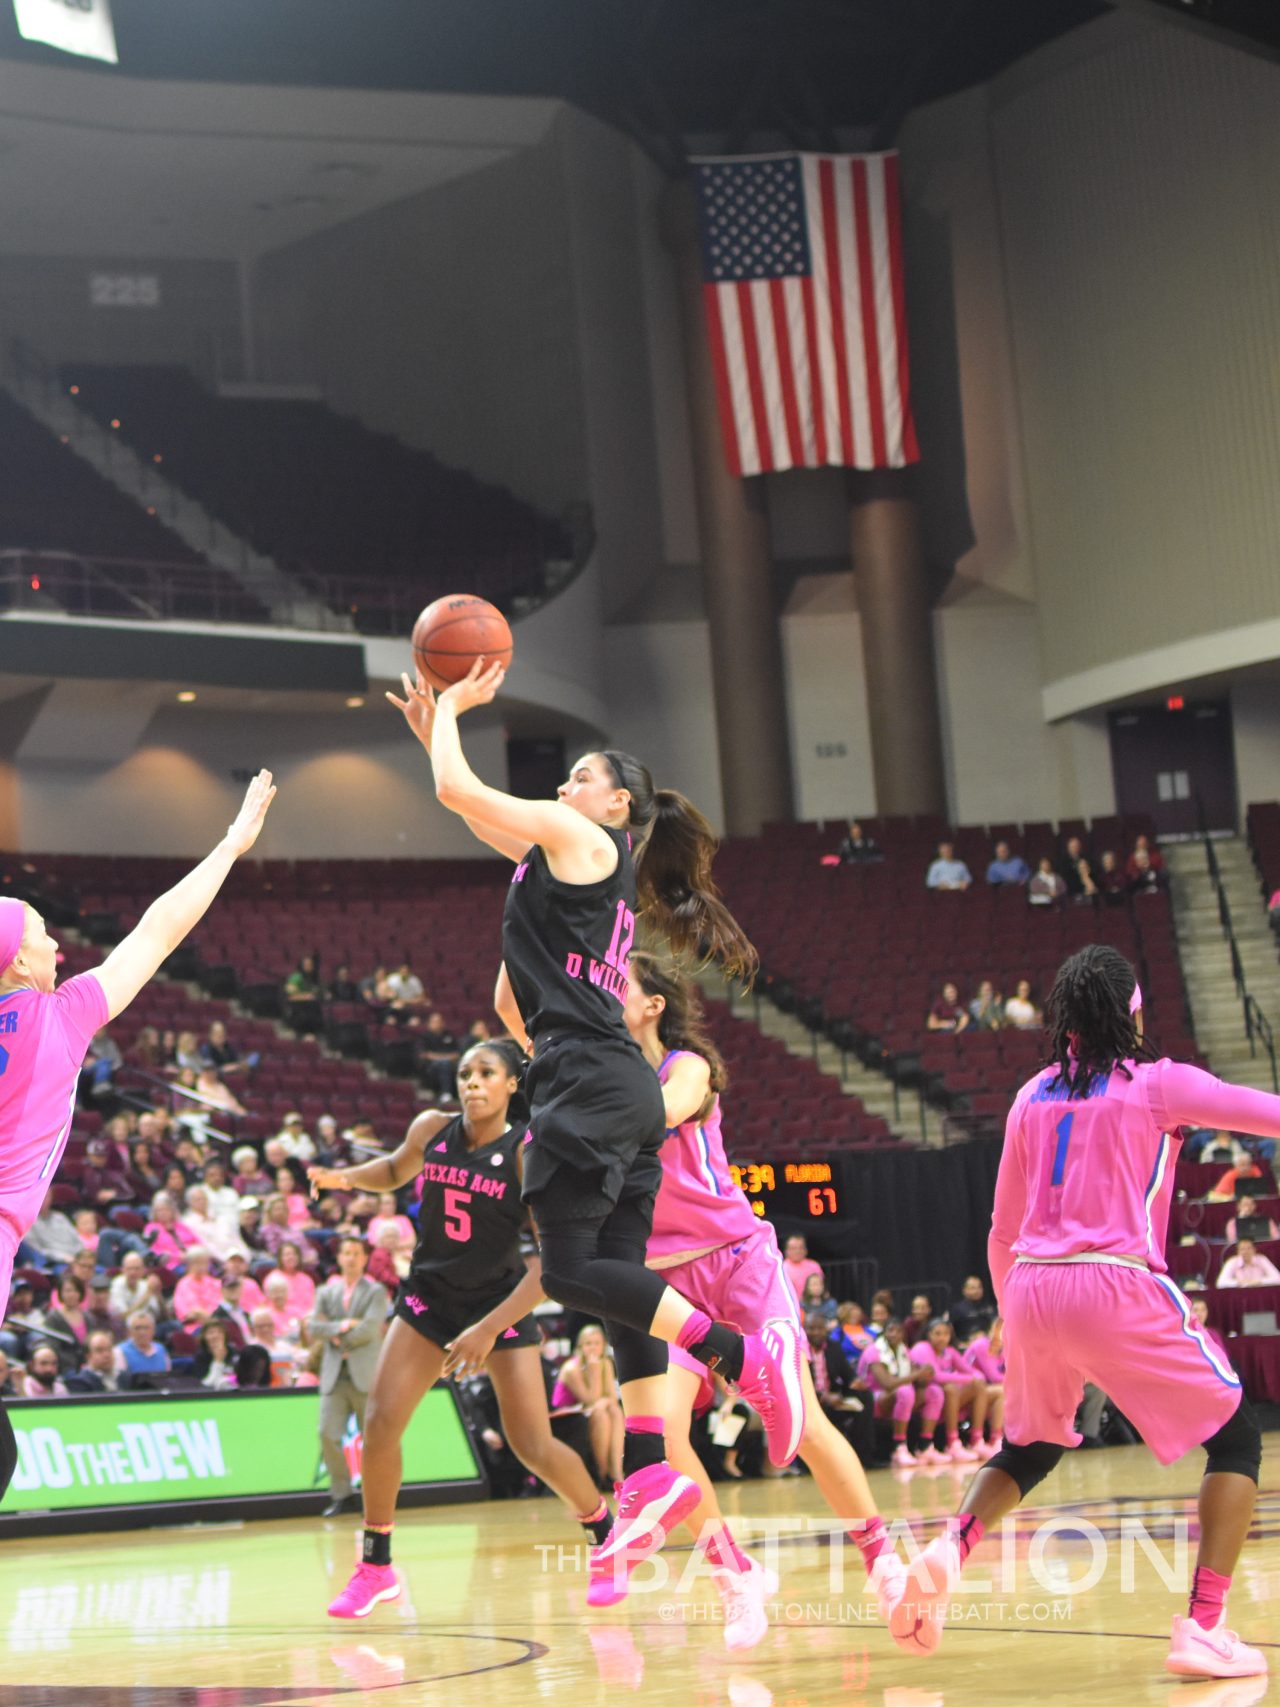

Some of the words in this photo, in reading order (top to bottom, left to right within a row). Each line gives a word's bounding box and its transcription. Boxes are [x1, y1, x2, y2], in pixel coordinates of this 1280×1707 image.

[604, 899, 635, 982] 12
[1050, 1111, 1074, 1185] 1
[423, 1162, 470, 1188] TEXAS
[470, 1173, 507, 1200] A&M
[808, 1187, 838, 1216] 67
[443, 1188, 472, 1243] 5
